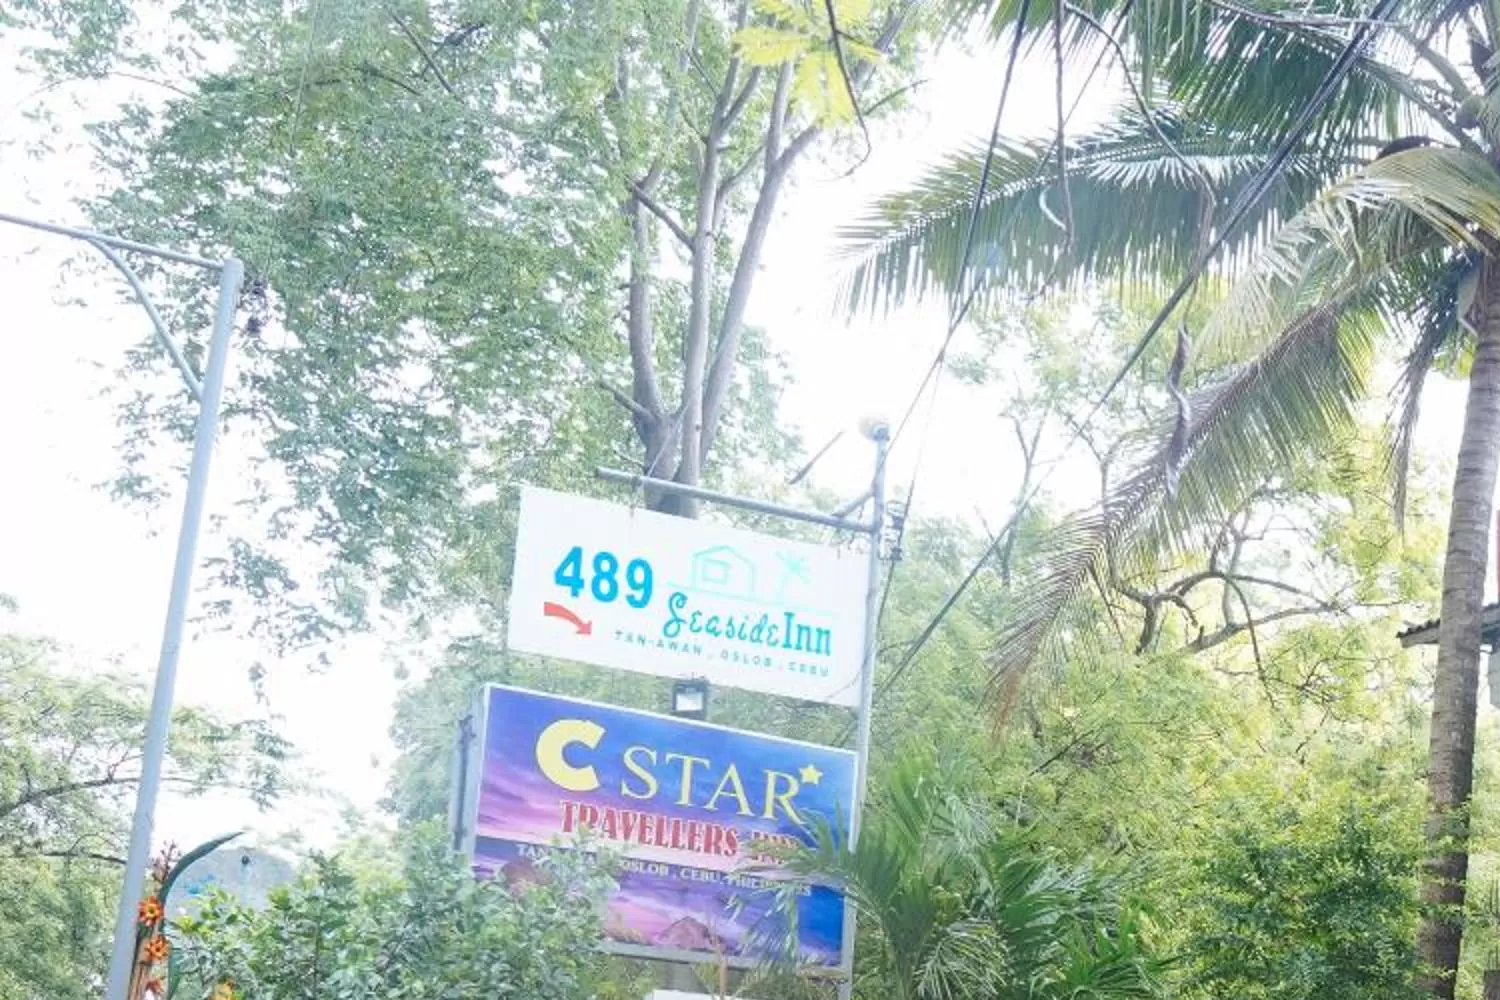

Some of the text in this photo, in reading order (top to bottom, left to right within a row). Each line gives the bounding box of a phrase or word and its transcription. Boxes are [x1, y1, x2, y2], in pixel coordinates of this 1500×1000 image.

[554, 546, 654, 609] 489
[535, 718, 807, 825] C STAR
[560, 800, 740, 858] TRAVELLERS
